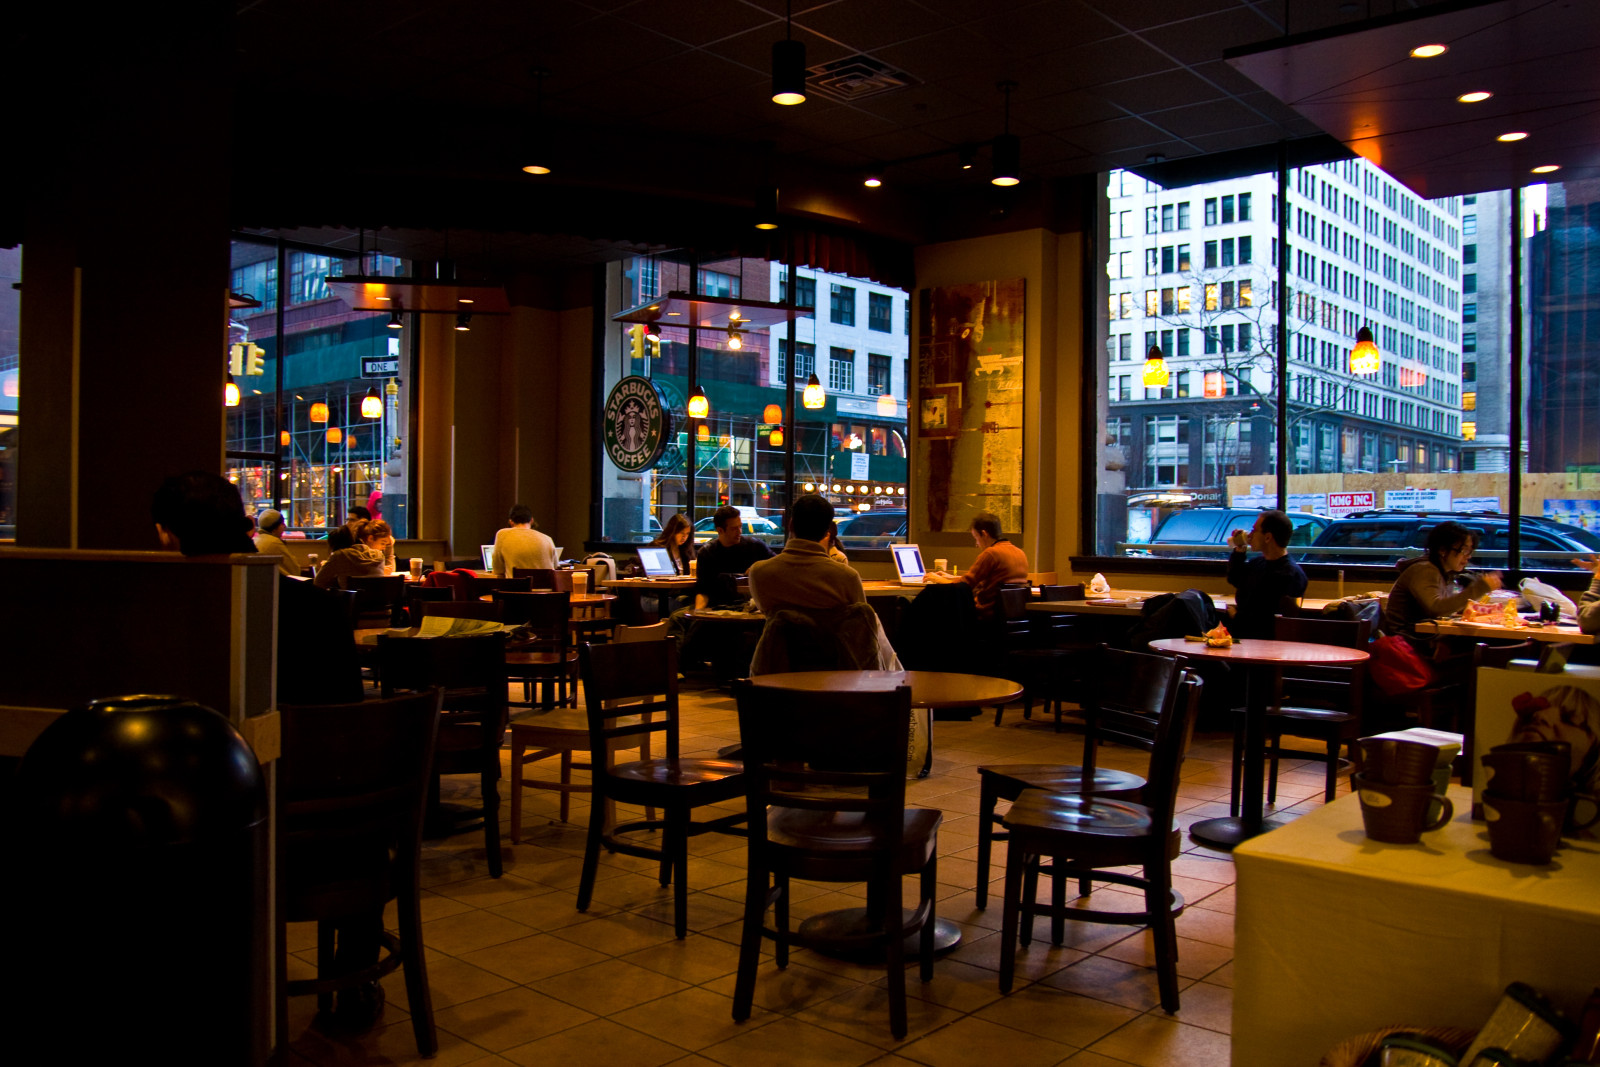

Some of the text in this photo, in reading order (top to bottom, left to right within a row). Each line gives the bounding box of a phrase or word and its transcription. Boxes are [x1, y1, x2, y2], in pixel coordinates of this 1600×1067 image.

[371, 363, 388, 371] ONE
[607, 382, 659, 421] STARBUCKS
[612, 444, 651, 467] COFFEE
[1330, 494, 1372, 506] MMG INC.
